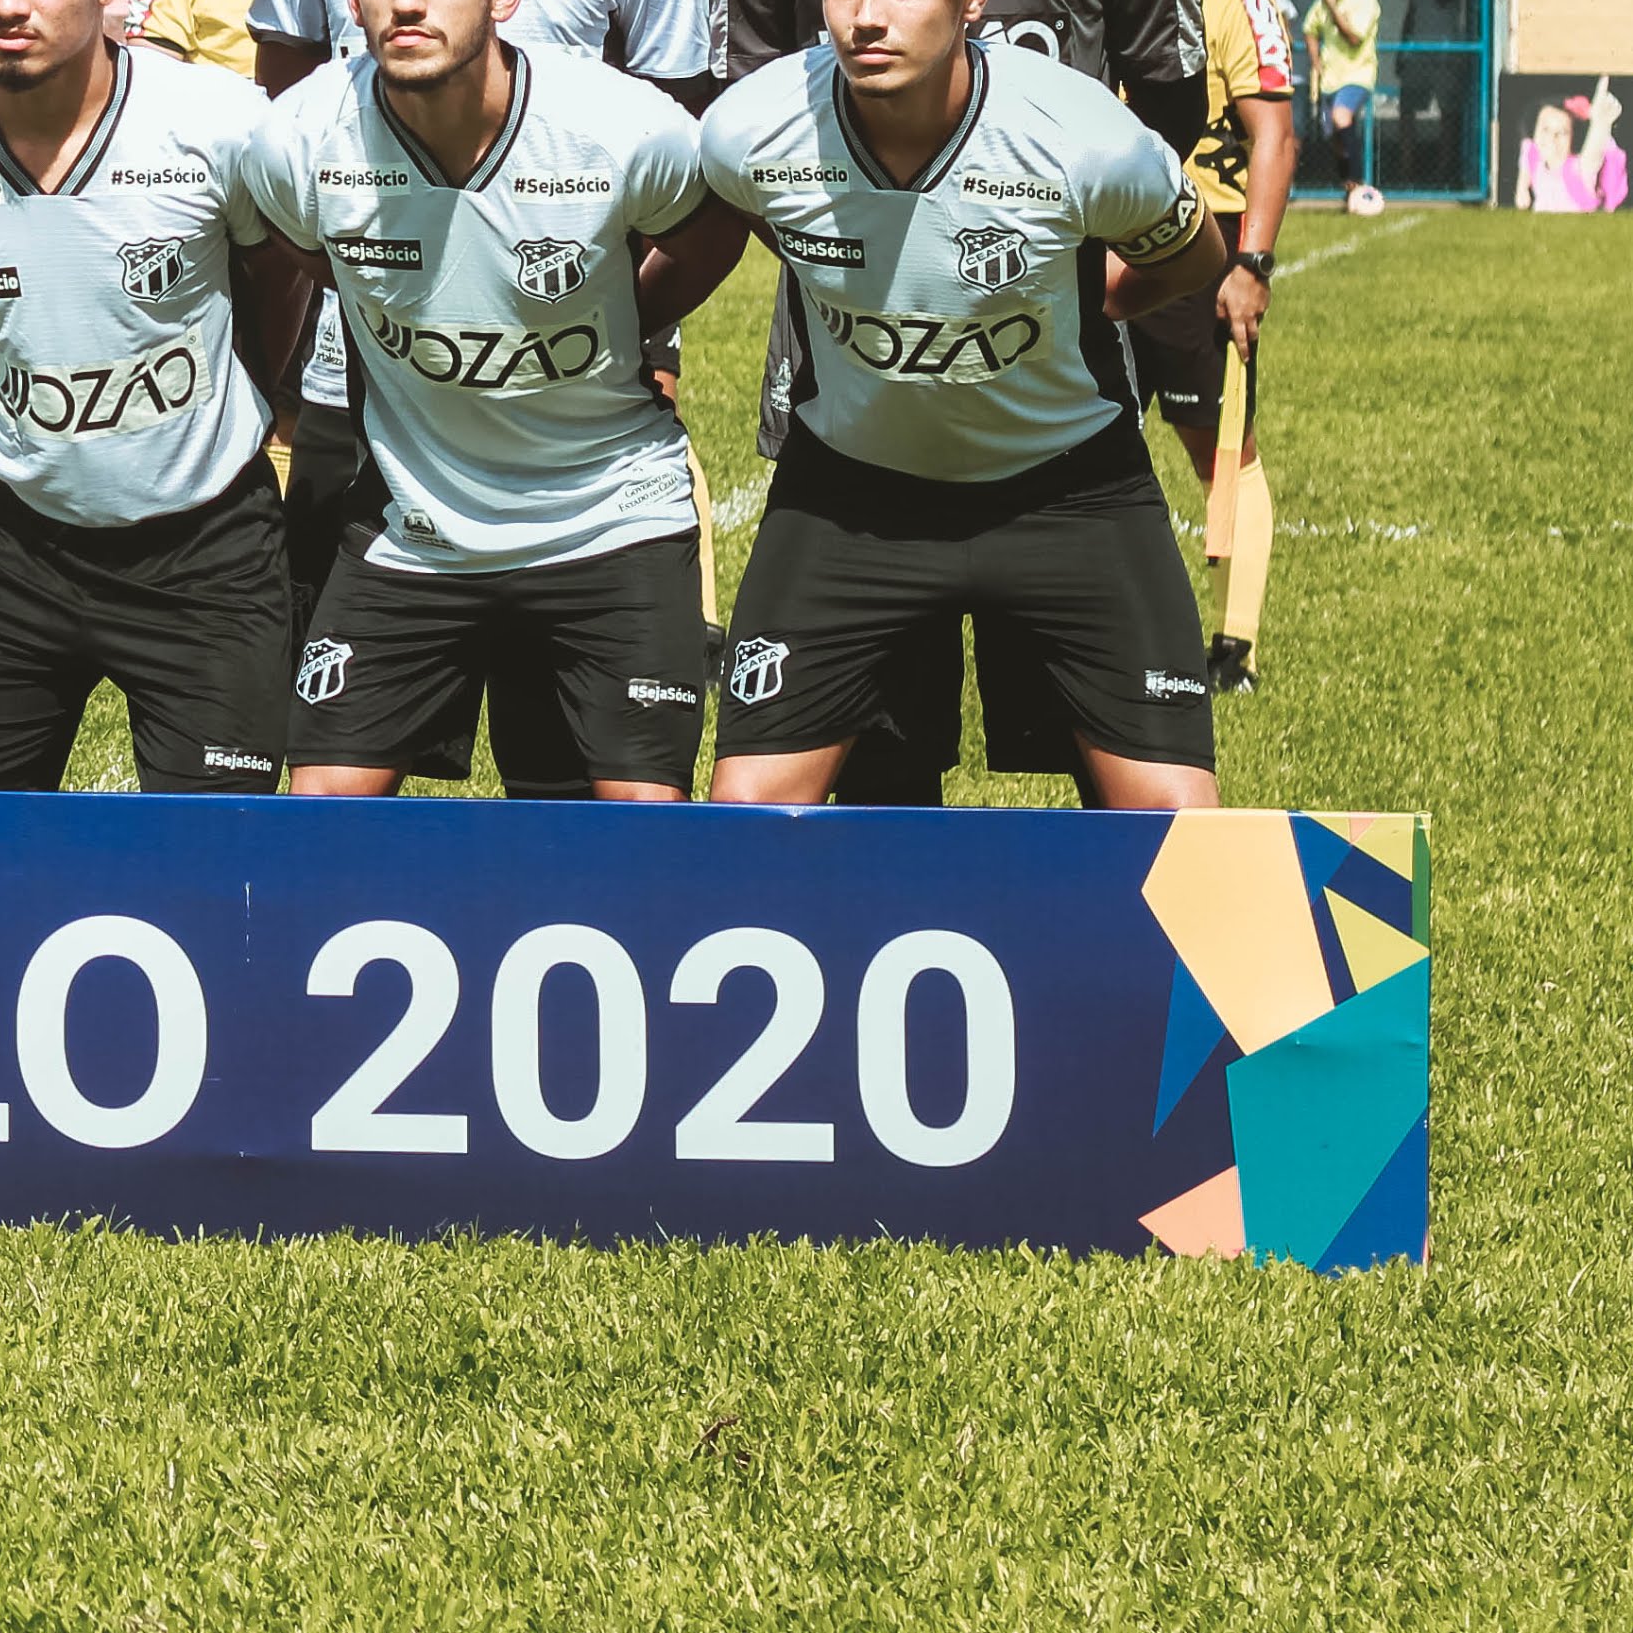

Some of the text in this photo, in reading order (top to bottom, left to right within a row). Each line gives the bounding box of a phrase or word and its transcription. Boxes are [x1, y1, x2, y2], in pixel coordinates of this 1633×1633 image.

[111, 168, 207, 186] #SejaSócio
[319, 170, 409, 189] #SejaSócio
[514, 175, 611, 197] #SejaSócio
[753, 166, 849, 186] #SejaSócio
[963, 176, 1063, 203] #SejaSócio
[627, 682, 697, 704] #SejaSócio
[205, 751, 272, 771] #SejaSócio
[305, 919, 1017, 1166] 2020
